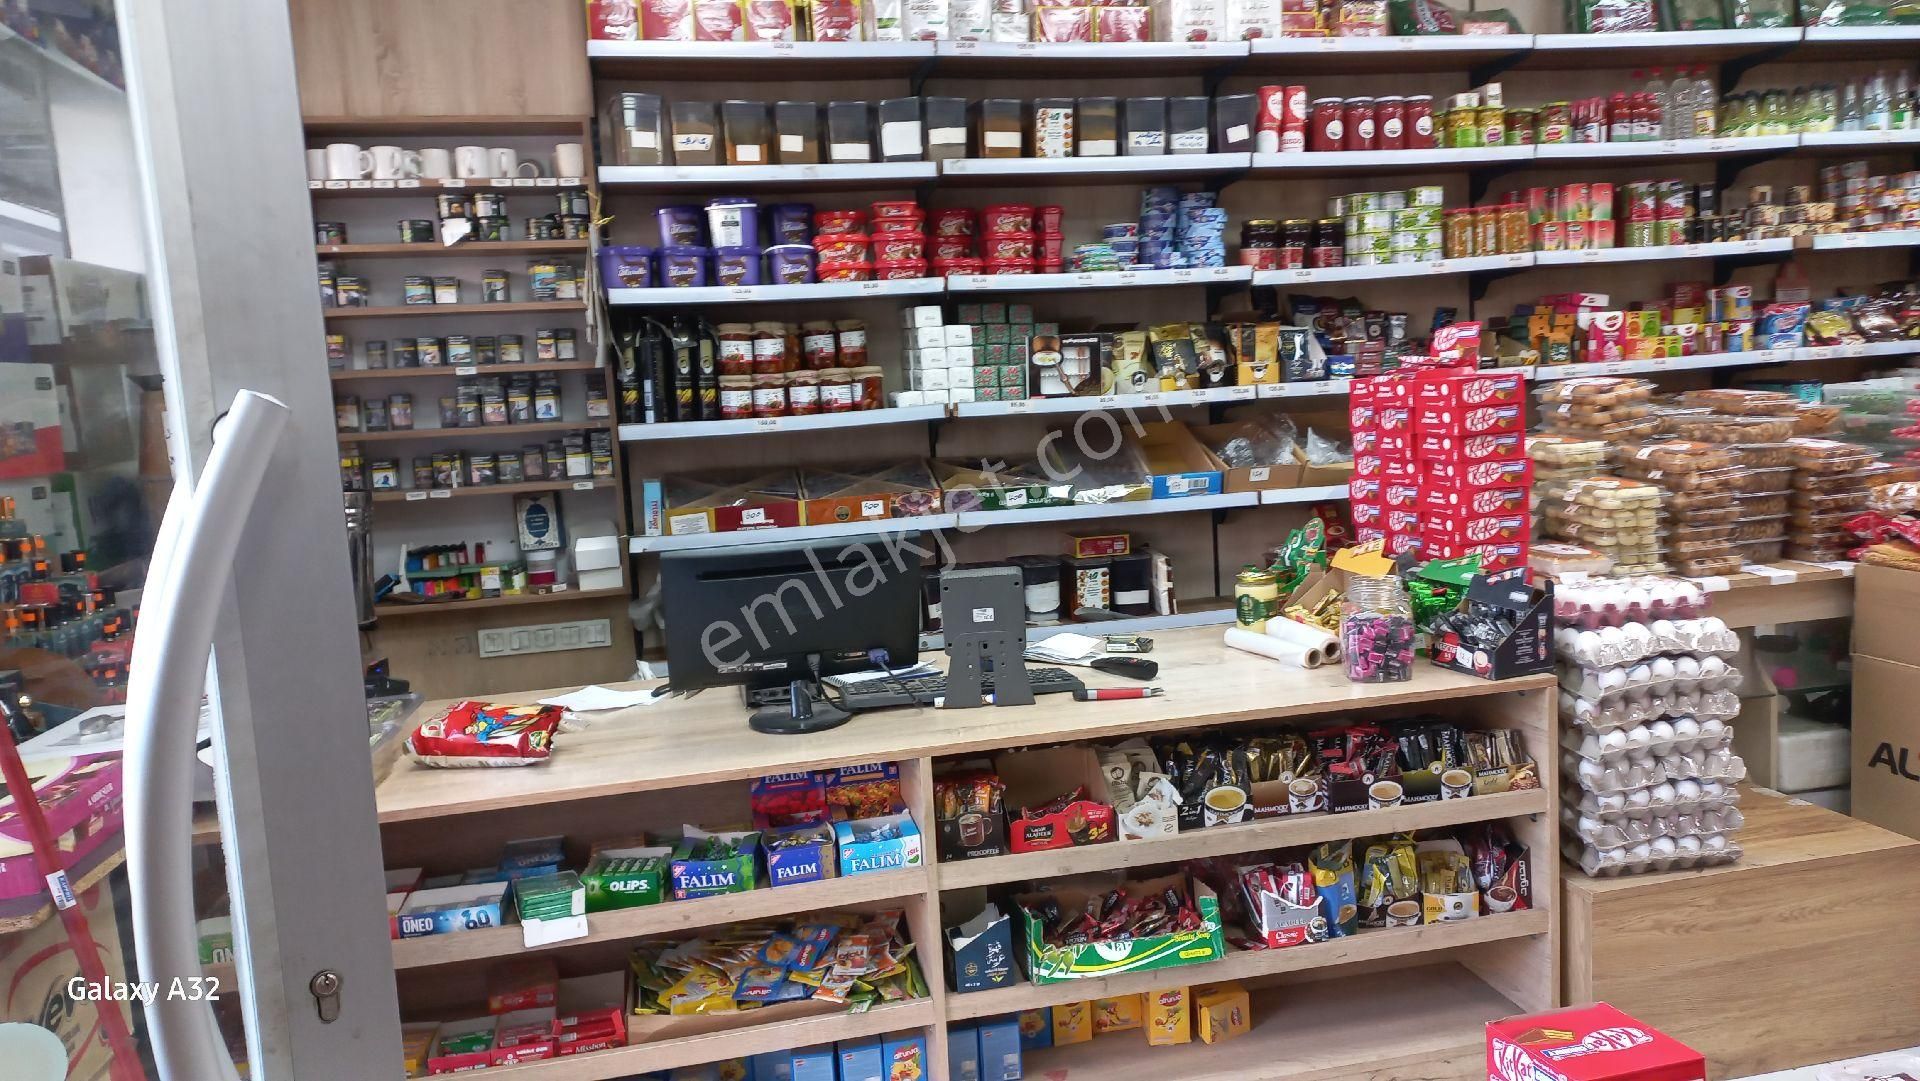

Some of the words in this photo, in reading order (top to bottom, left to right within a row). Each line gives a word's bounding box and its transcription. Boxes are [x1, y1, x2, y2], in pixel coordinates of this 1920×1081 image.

[777, 862, 818, 879] FALIM
[851, 853, 903, 872] FALIM
[680, 872, 736, 889] FALIM
